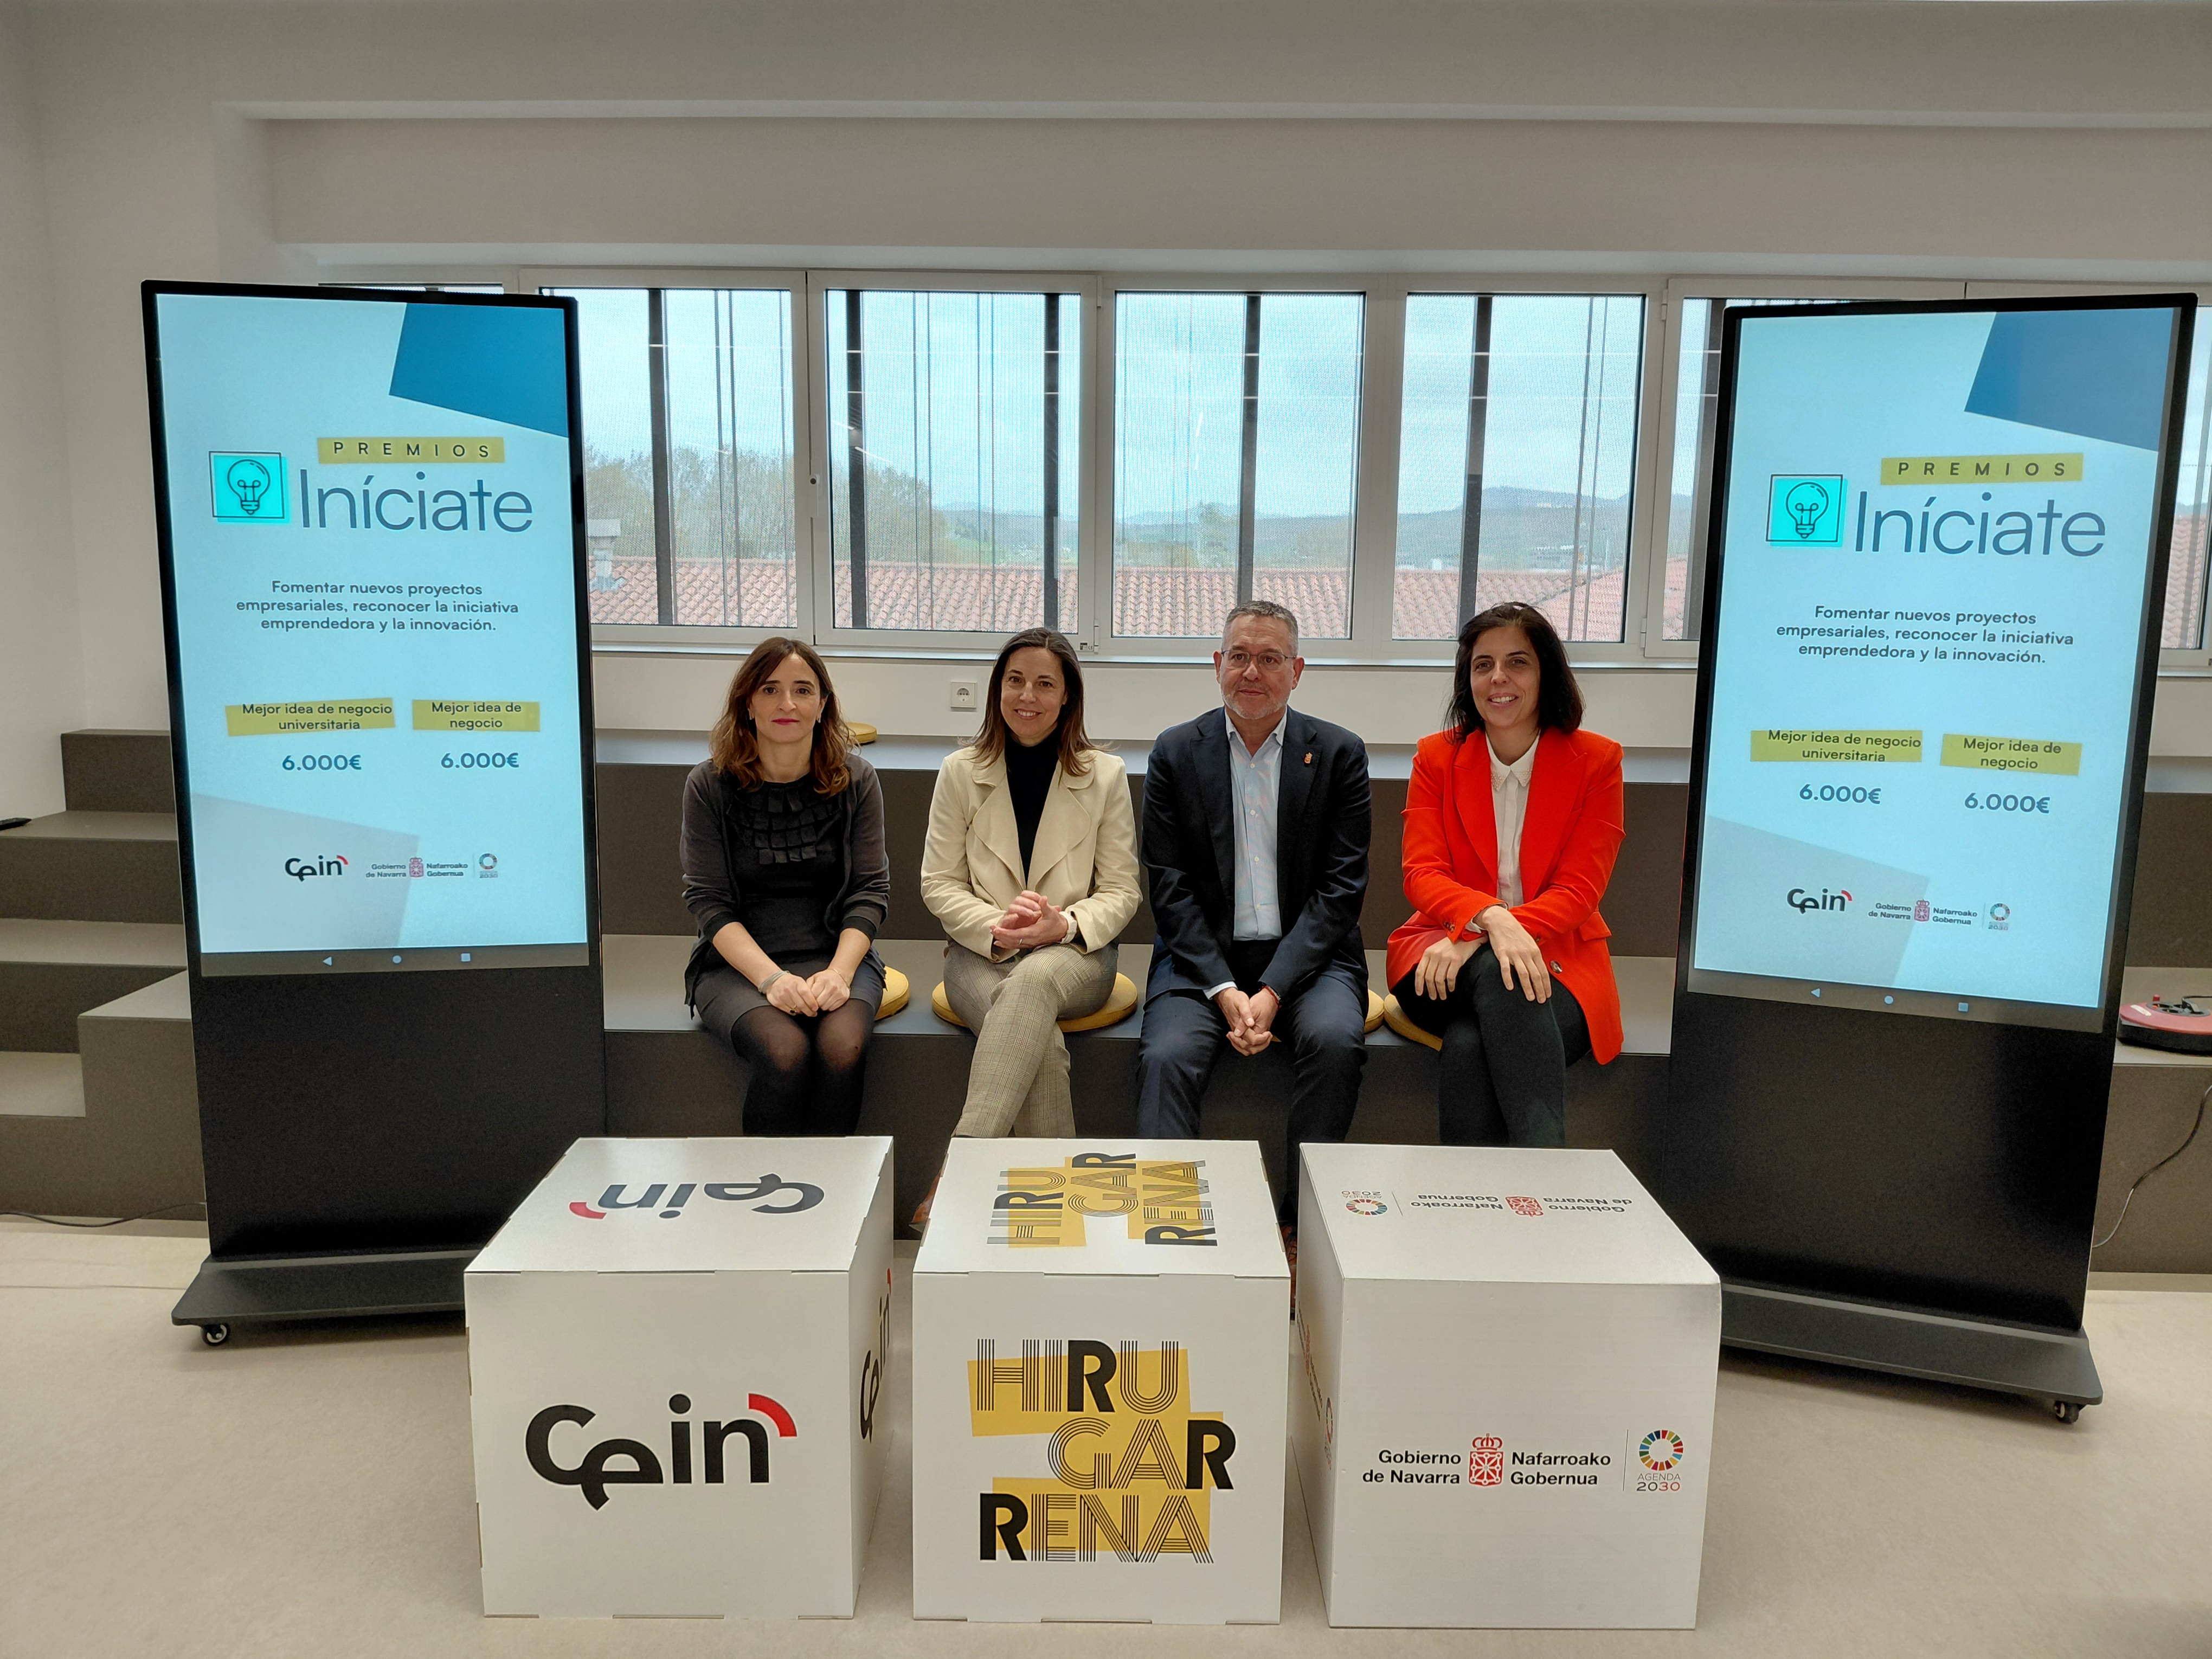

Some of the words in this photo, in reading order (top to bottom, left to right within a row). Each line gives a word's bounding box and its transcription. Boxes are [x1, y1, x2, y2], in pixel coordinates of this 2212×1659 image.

[333, 441, 489, 458] PREMIOS
[1898, 462, 2066, 476] PREMIOS
[300, 468, 533, 532] Iníciate
[1855, 491, 2106, 557] Iníciate
[272, 580, 345, 594] Fomentar
[350, 583, 403, 595] nuevos
[407, 582, 483, 599] proyectos
[236, 599, 348, 613] empresariales,
[352, 601, 431, 613] reconocer
[435, 600, 448, 613] la
[452, 600, 519, 614] iniciativa
[1815, 606, 1890, 620] Fomentar
[1895, 610, 1951, 621] nuevos
[1956, 608, 2036, 626] proyectos
[260, 616, 375, 632] emprendedora
[379, 620, 388, 633] y
[392, 618, 406, 631] la
[409, 618, 496, 632] innovación.
[1776, 624, 1889, 640] empresariales,
[1895, 628, 1978, 642] reconocer
[1982, 629, 1996, 643] la
[2001, 629, 2074, 645] iniciativa
[1798, 643, 1915, 659] emprendedora
[1919, 650, 1930, 663] y
[1933, 646, 1947, 660] la
[1952, 647, 2046, 664] innovación.
[242, 704, 281, 716] Mejor
[284, 704, 314, 715] idea
[317, 704, 335, 714] de
[338, 704, 393, 717] negocio
[432, 702, 470, 715] Mejor
[473, 703, 501, 713] idea
[505, 703, 522, 713] de
[279, 719, 361, 730] universitaria
[449, 718, 503, 731] negocio
[1768, 729, 1807, 744] Mejor
[1811, 732, 1840, 744] idea
[1843, 734, 1862, 745] de
[1866, 735, 1922, 750] negocio
[1963, 738, 2005, 752] Mejor
[2008, 740, 2040, 753] idea
[2043, 742, 2062, 754] de
[282, 755, 362, 771] 6.000€
[441, 753, 519, 769] 6.000€
[1802, 749, 1886, 762] universitaria
[1980, 757, 2039, 770] negocio
[1799, 783, 1882, 805] 6.000€
[1964, 793, 2051, 814] 6.000€
[1875, 903, 1912, 911] Gobierno
[1880, 911, 1911, 919] Navarra
[1933, 907, 1978, 917] Nafarroako
[1068, 1153, 1139, 1218] GAR
[986, 1170, 1066, 1245] HIRU
[1142, 1160, 1218, 1246] RENA
[1411, 1201, 1504, 1210] Nafarroako
[977, 1339, 1179, 1414] HIRU
[1048, 1417, 1237, 1490] GAR
[1378, 1449, 1462, 1465] Gobierno
[1511, 1452, 1612, 1466] Nafarroako
[1362, 1469, 1385, 1483] de
[1390, 1470, 1461, 1484] Navarra
[1510, 1471, 1598, 1486] Gobernua
[1637, 1472, 1681, 1481] AGENDA
[1637, 1481, 1681, 1491] 2030
[979, 1493, 1214, 1564] RENA
